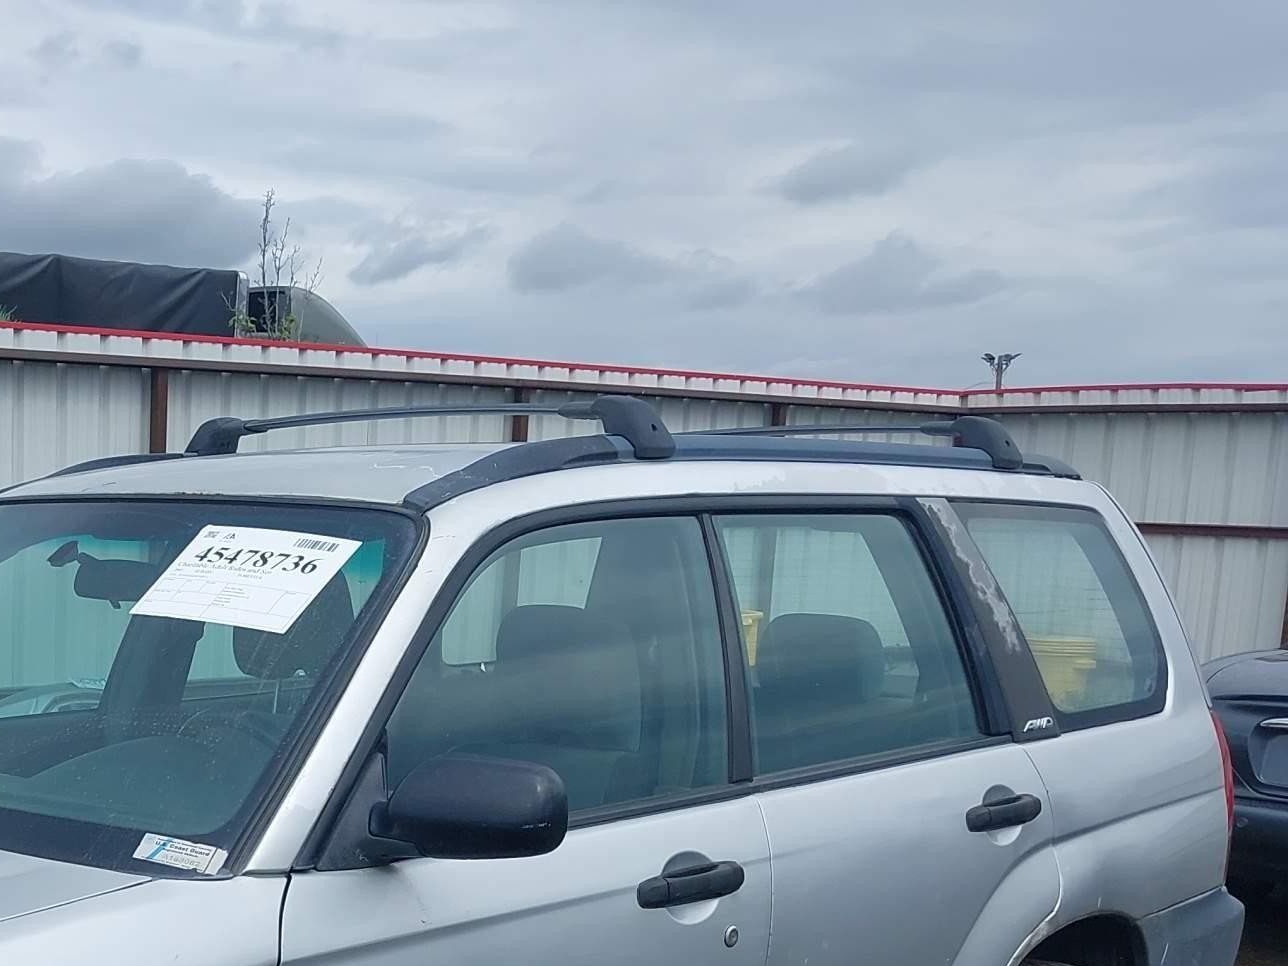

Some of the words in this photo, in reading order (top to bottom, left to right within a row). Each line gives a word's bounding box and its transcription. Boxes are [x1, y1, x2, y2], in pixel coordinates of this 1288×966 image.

[195, 545, 324, 575] 45478736
[169, 843, 188, 851] Coast
[190, 848, 211, 857] Guard
